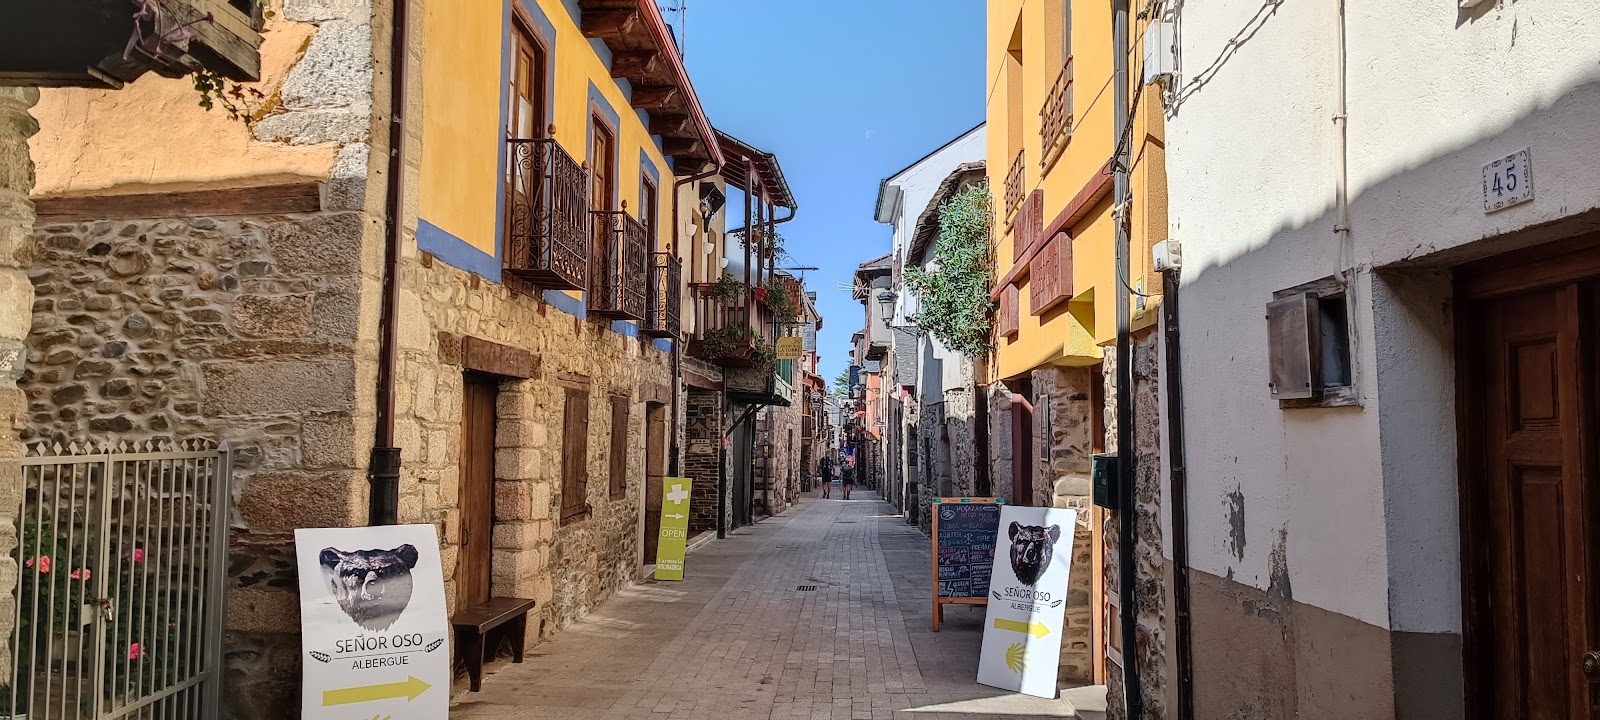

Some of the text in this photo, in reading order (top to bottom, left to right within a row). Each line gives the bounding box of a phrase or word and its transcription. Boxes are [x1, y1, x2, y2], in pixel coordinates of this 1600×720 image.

[1492, 163, 1517, 197] 45
[661, 529, 685, 538] OPEN
[1004, 586, 1051, 602] SEÑOR OSO
[1010, 602, 1041, 614] ALBERGUE
[335, 633, 423, 654] SEÑOR OSO
[352, 655, 409, 670] ALBERGUE
